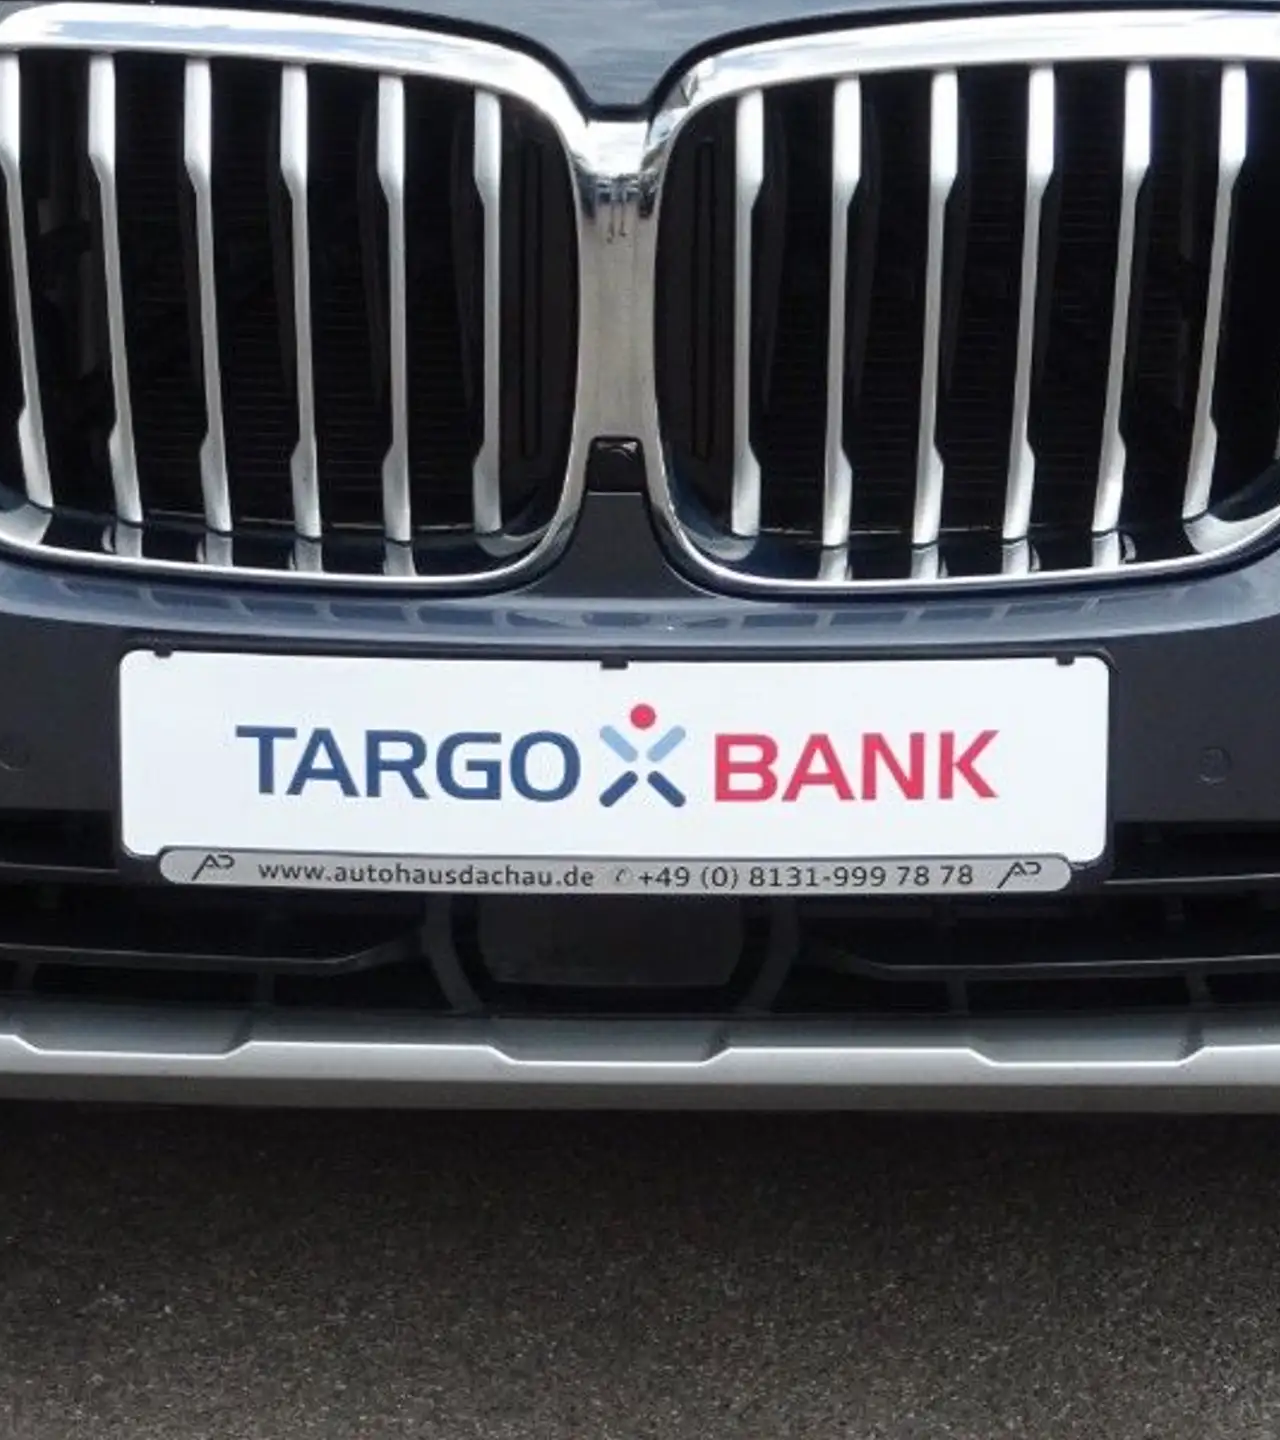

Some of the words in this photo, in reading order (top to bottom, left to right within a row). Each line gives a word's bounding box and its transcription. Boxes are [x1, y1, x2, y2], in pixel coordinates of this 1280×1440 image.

[235, 724, 582, 803] TARGO
[713, 729, 1001, 803] BANK
[257, 862, 596, 888] www.autohausdachau.de
[638, 866, 691, 888] +49
[700, 865, 739, 890] (0)
[748, 865, 888, 888] 8131-999
[896, 865, 931, 887] 78
[939, 864, 974, 886] 78
